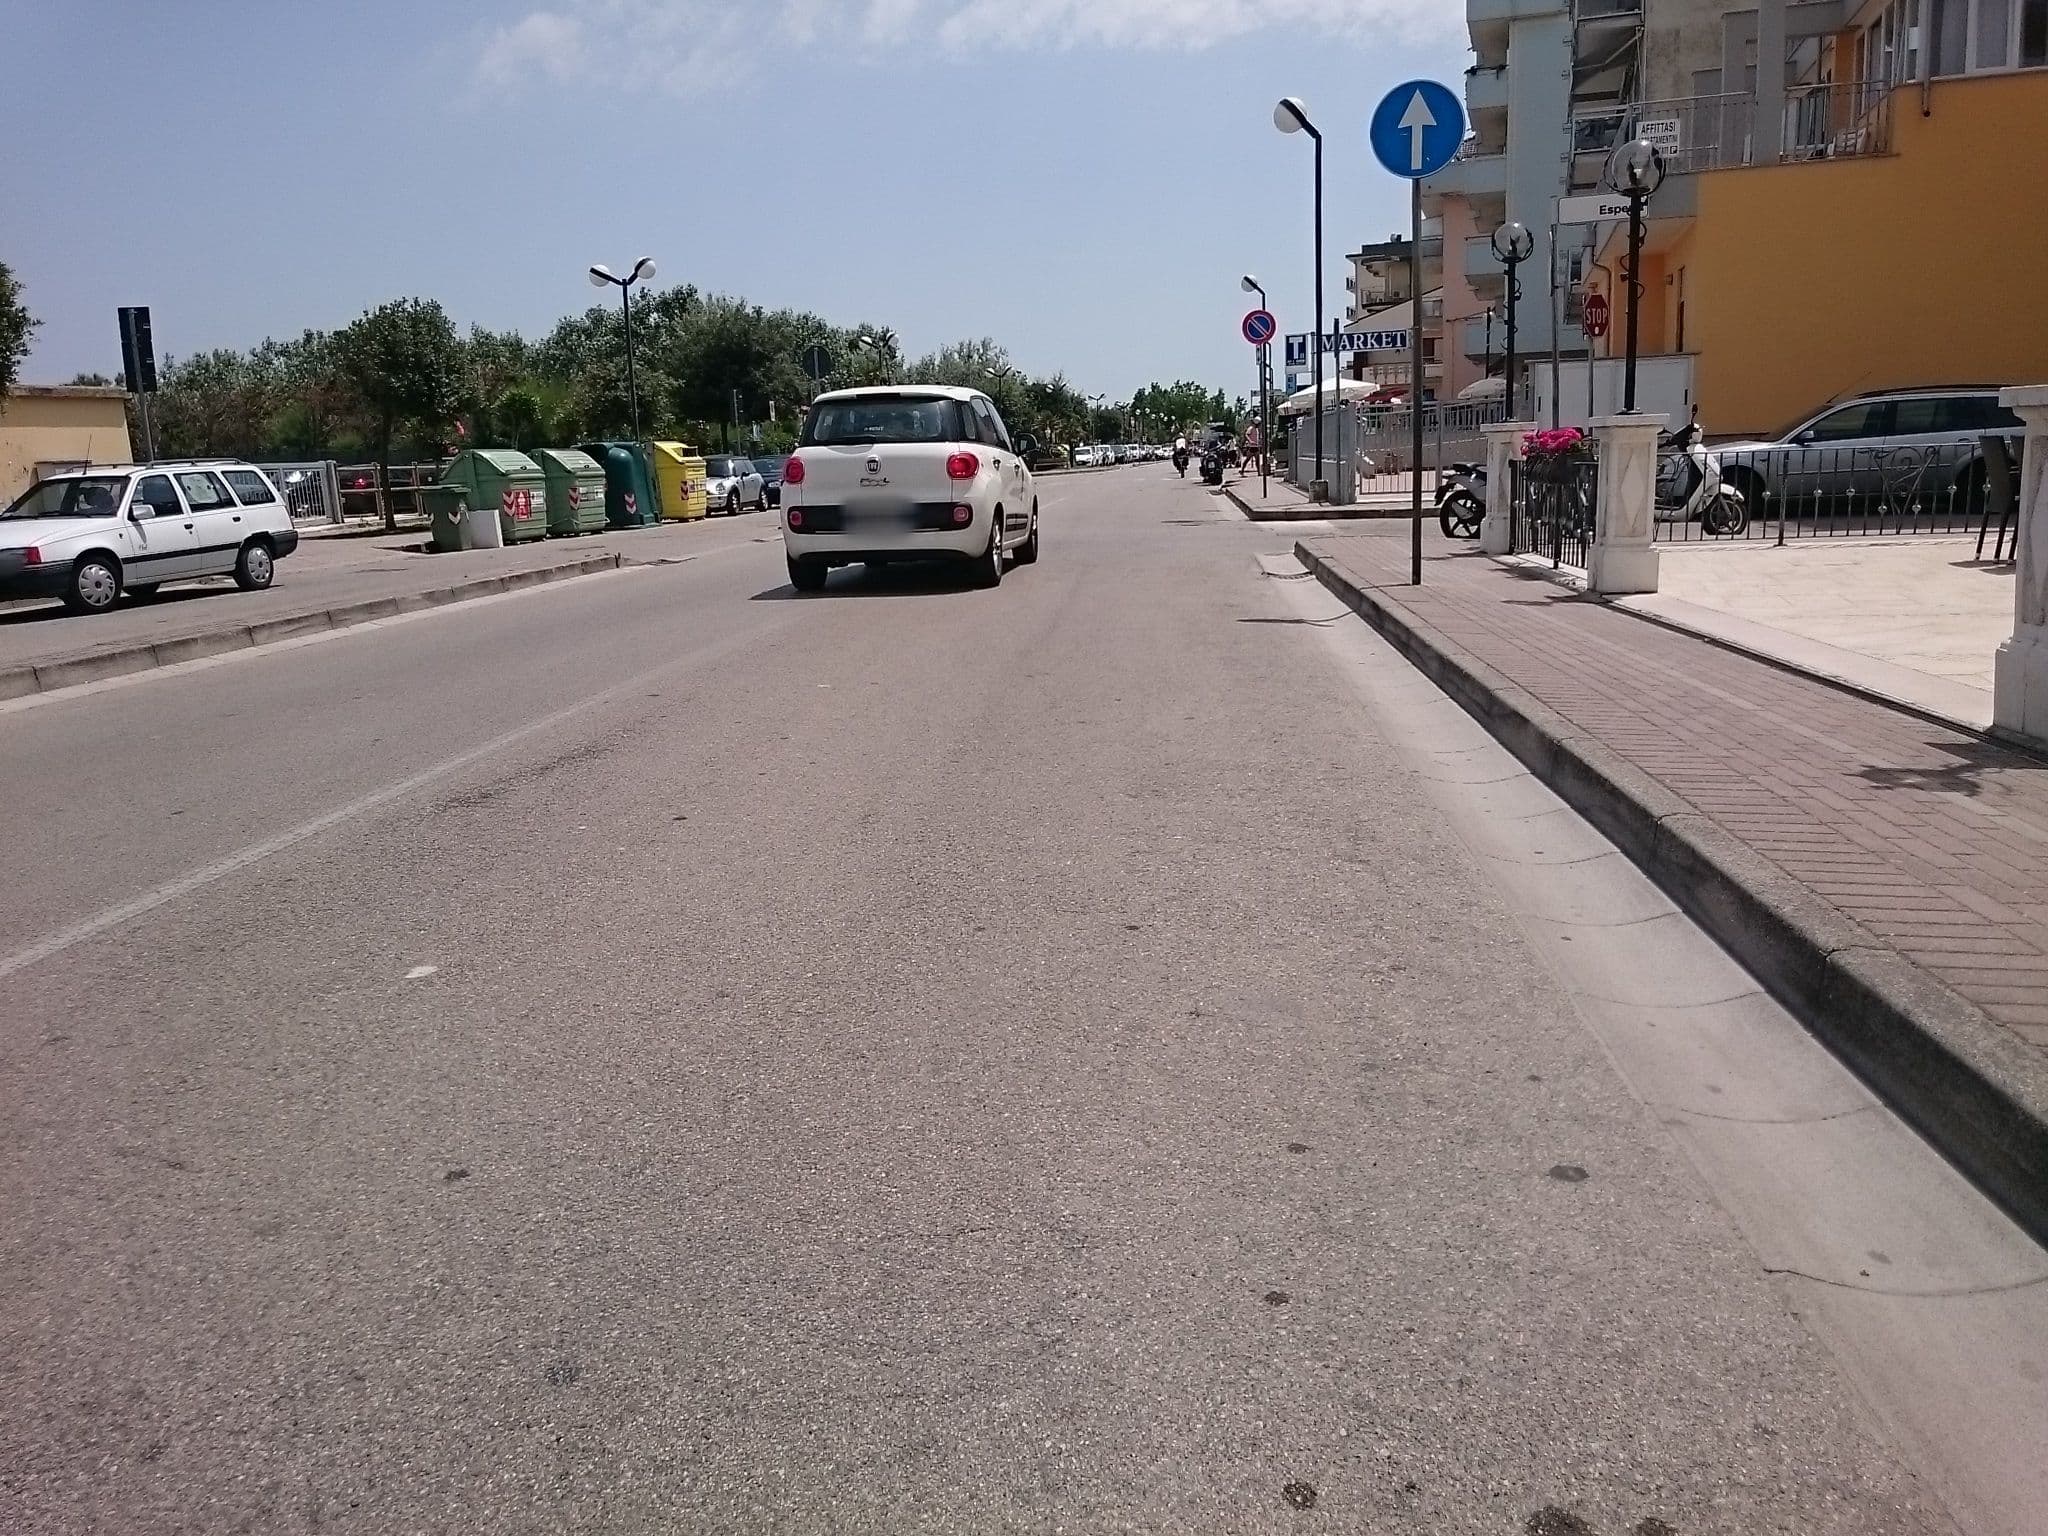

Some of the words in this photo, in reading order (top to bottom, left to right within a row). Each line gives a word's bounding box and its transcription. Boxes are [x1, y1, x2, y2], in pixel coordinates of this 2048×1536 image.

[1641, 121, 1676, 135] AFFITTASI
[1585, 307, 1608, 324] STOP
[1321, 331, 1406, 351] MARKET
